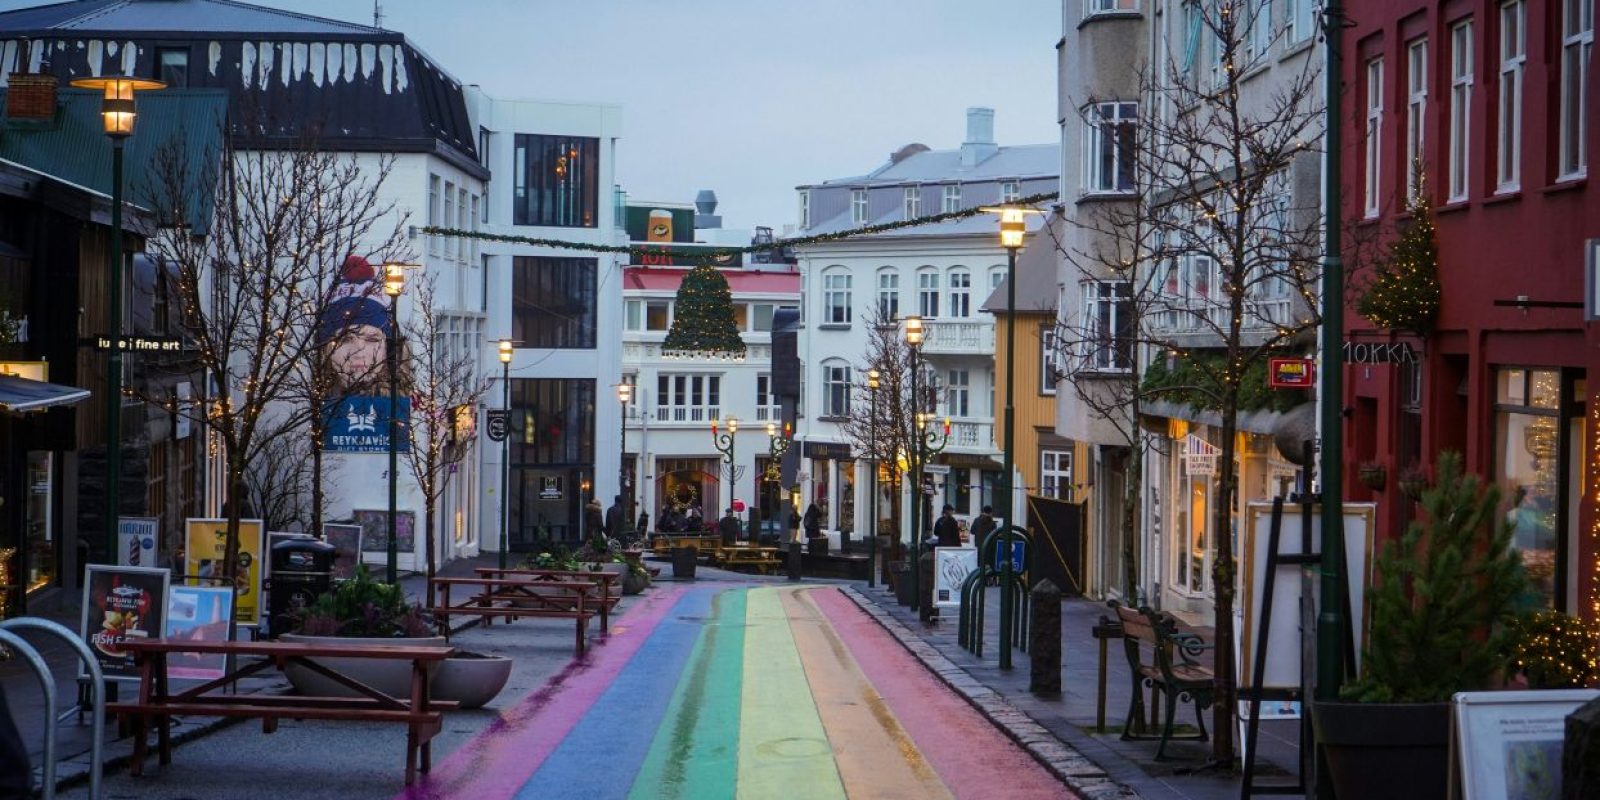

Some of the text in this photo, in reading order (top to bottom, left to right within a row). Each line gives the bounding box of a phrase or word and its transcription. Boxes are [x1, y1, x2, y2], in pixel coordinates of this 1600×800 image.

[135, 339, 159, 350] fine
[162, 341, 180, 351] art
[91, 633, 114, 645] FISH
